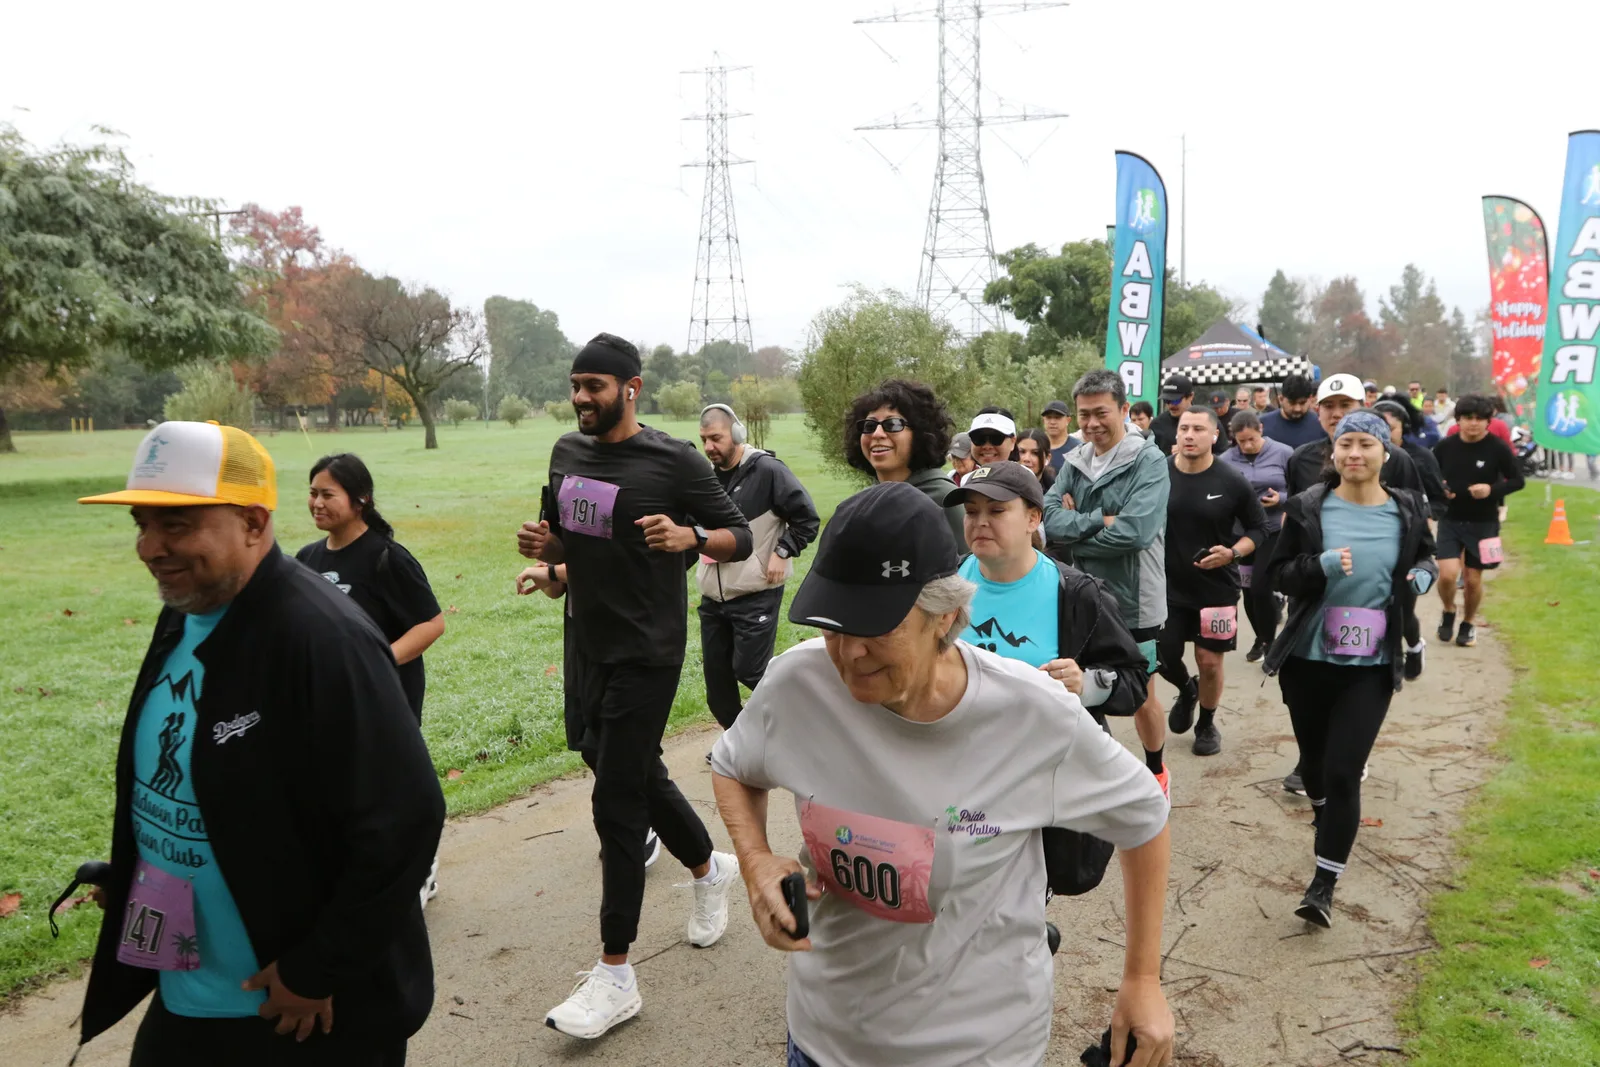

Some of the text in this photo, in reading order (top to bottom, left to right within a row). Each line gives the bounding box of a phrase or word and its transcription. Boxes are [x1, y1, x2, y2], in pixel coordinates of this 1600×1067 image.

[1495, 300, 1543, 320] Happy
[572, 497, 598, 527] 191
[1210, 619, 1232, 634] 606
[1339, 625, 1372, 647] 231
[213, 711, 261, 743] Dodgers
[176, 807, 206, 833] Pa
[959, 809, 986, 823] Pride
[966, 823, 1002, 837] Valley
[162, 838, 208, 868] Club
[829, 848, 901, 909] 600
[122, 898, 166, 954] 147
